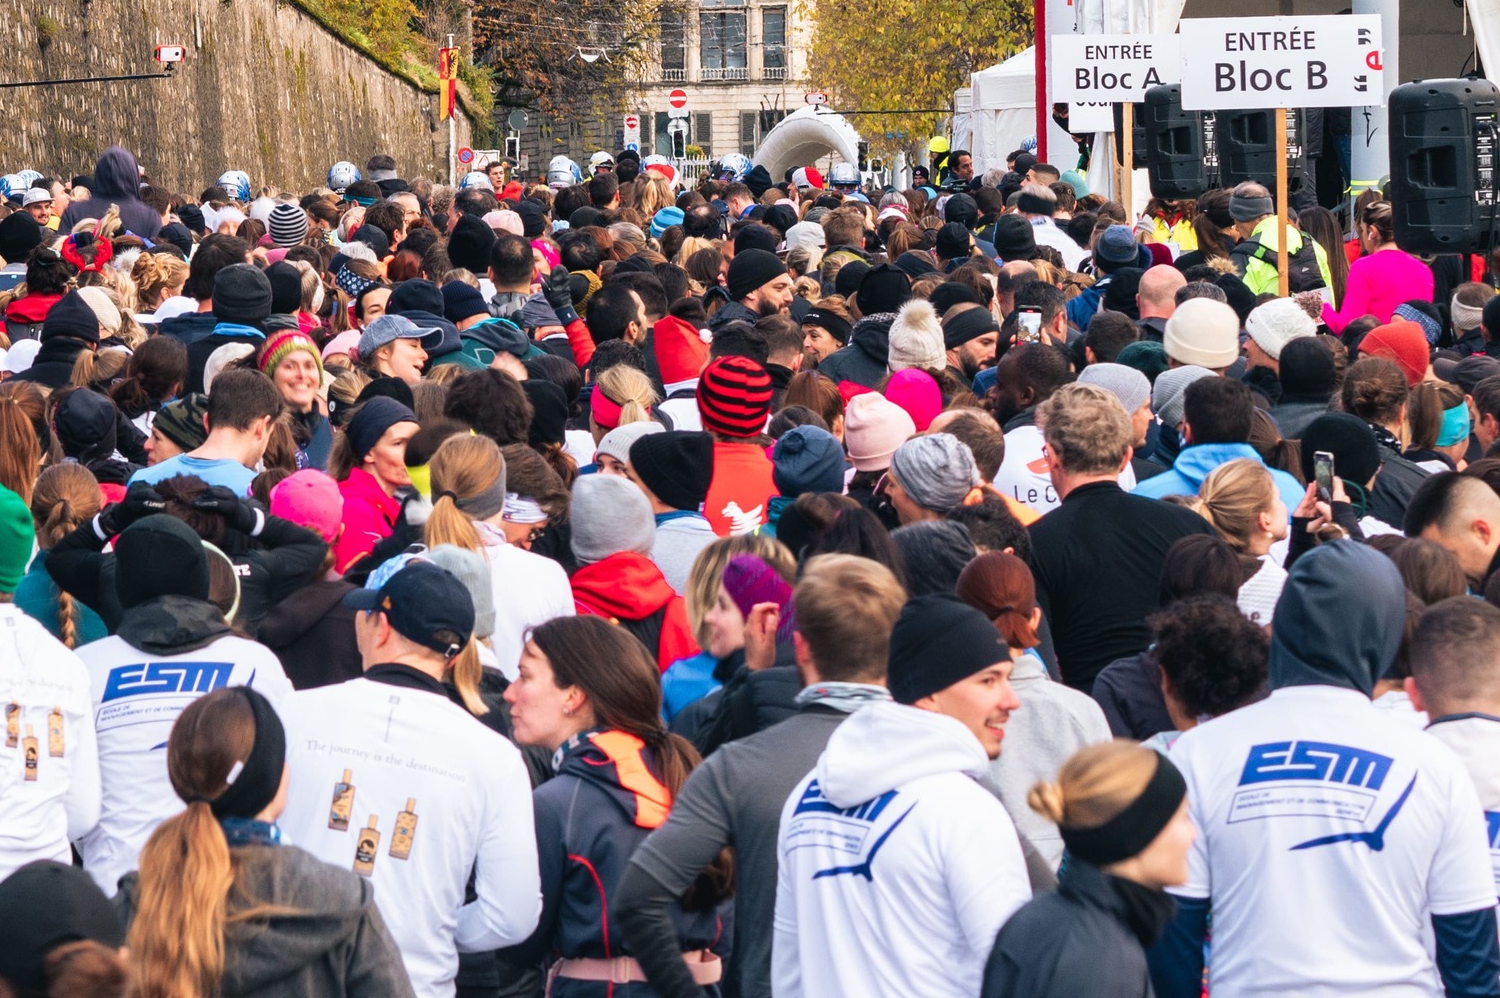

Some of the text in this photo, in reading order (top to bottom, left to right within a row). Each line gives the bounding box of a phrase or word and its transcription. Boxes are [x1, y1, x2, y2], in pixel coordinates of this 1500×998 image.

[1085, 41, 1153, 60] ENTRÉE
[1225, 26, 1315, 51] ENTRÉE
[1075, 66, 1164, 90] Bloc A
[1215, 60, 1328, 92] Bloc B
[1014, 485, 1037, 503] Le
[101, 661, 236, 703] ESM
[306, 739, 327, 751] The
[329, 742, 370, 760] journey
[385, 753, 402, 766] the
[405, 758, 466, 782] destination
[1237, 740, 1395, 792] ESM
